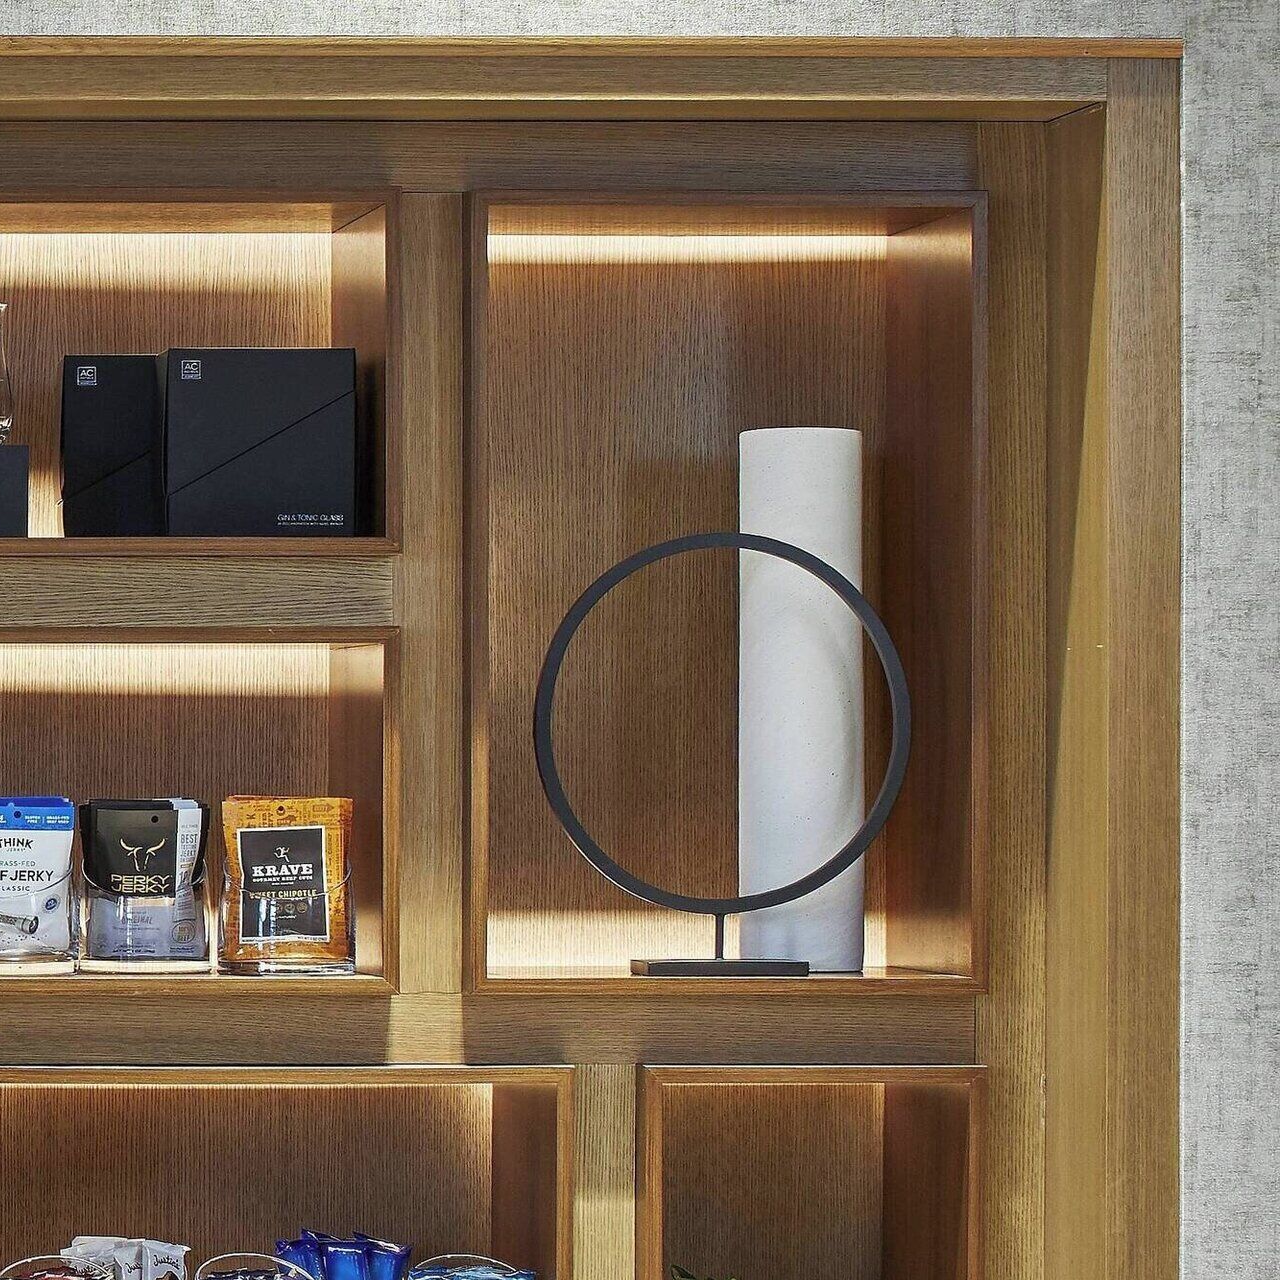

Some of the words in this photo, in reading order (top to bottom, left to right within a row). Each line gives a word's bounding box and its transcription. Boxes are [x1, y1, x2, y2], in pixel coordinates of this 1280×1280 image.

[181, 833, 198, 844] BEST
[9, 869, 54, 882] JERKY
[252, 863, 313, 877] KRAVE
[111, 873, 170, 885] PERKY
[111, 883, 170, 894] JERKY
[278, 889, 317, 899] CHIPOTLE
